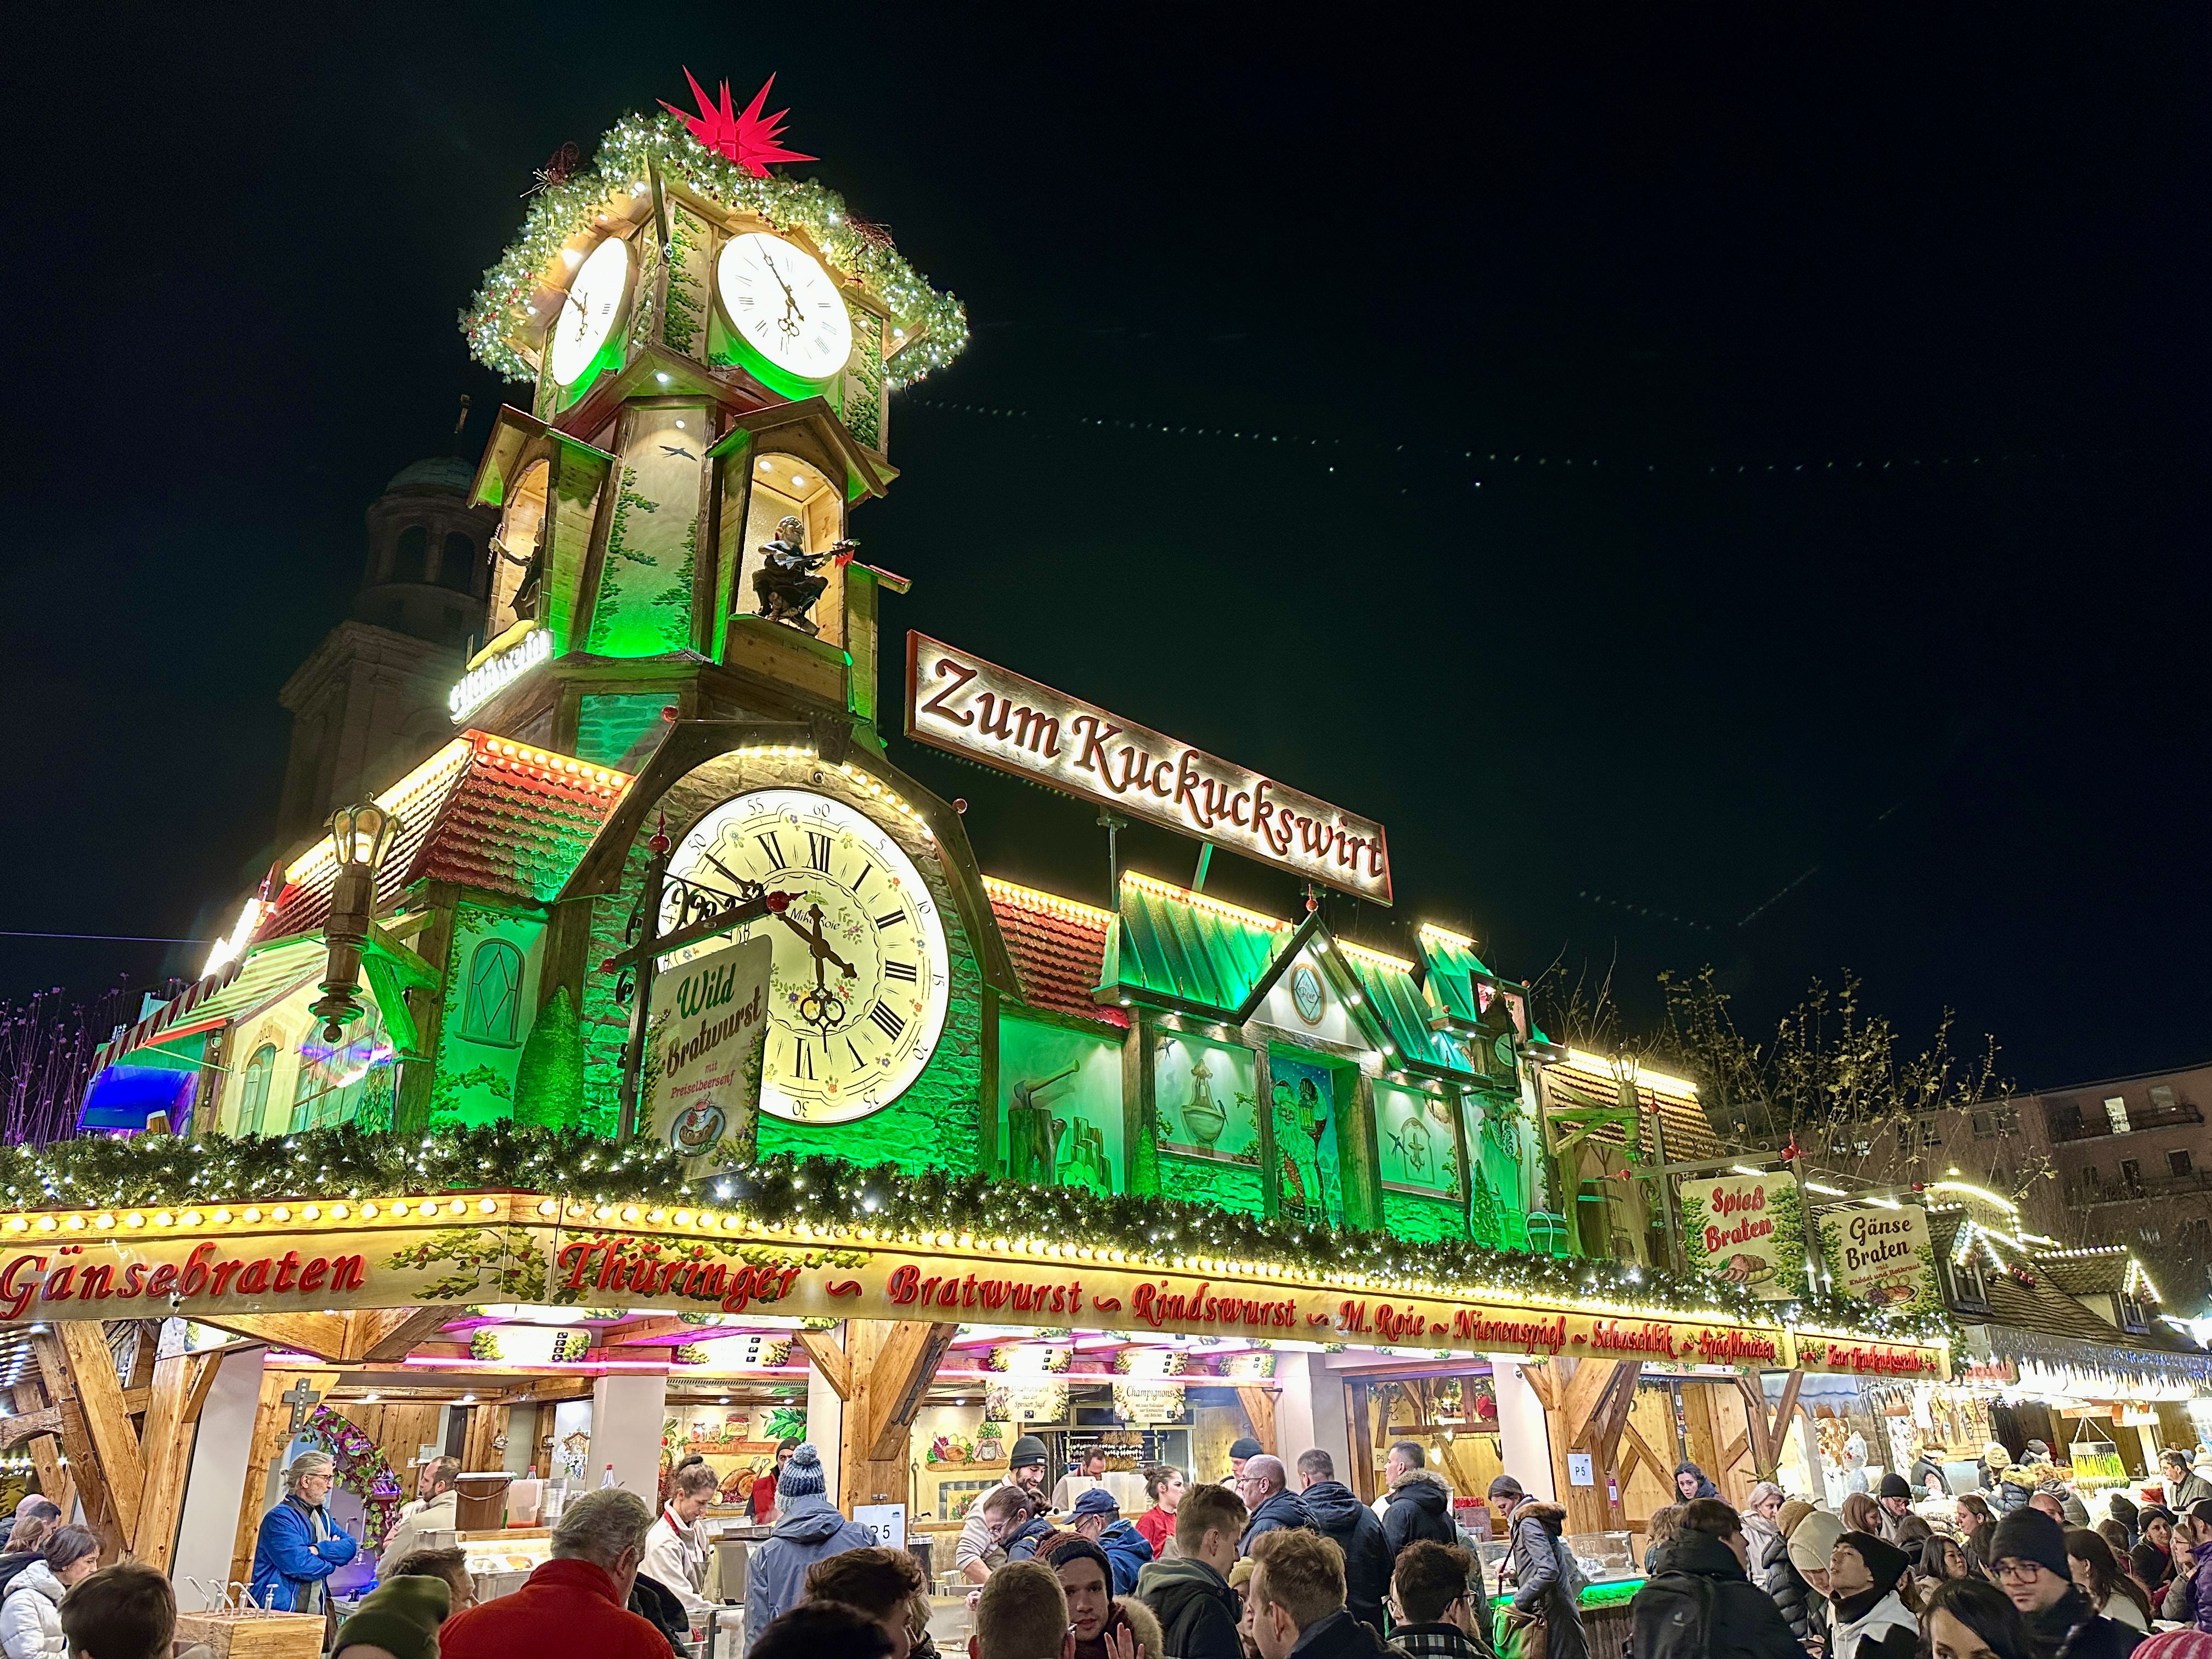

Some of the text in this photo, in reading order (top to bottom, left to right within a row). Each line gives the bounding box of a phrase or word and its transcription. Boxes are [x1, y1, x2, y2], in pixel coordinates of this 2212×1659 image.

[921, 658, 1383, 878] Zum Kuckuckswirt
[747, 797, 764, 816] 55
[813, 803, 830, 817] 60
[688, 833, 706, 856] 50
[753, 831, 792, 876] XI
[801, 831, 836, 876] XII
[875, 838, 887, 850] 5
[917, 900, 931, 914] 10
[884, 957, 917, 987] III
[676, 962, 736, 1019] Wild
[666, 985, 761, 1079] Bratwurst
[912, 1038, 928, 1060] 20
[705, 1060, 718, 1074] mit
[670, 1069, 736, 1099] Preiselbeersenf
[792, 1099, 810, 1118] 30
[863, 1088, 879, 1109] 25
[1712, 1185, 1765, 1218] Spieß
[1705, 1217, 1775, 1252] Braten
[1849, 1217, 1913, 1246] Gänse
[1845, 1240, 1911, 1271] Braten
[1875, 1263, 1889, 1271] mit
[0, 1241, 365, 1318] Gänsebraten
[1849, 1262, 1921, 1285] Knödel und Rotkraut
[557, 1237, 802, 1312] Thüringer
[887, 1264, 1083, 1314] Bratwurst
[1132, 1280, 1297, 1328] Rindswurst
[1339, 1300, 1373, 1332] M.
[1375, 1304, 1425, 1342] Roie
[1453, 1309, 1566, 1355] Nierenspieß
[1591, 1319, 1677, 1359] Schaschlik
[1126, 1385, 1173, 1401] Champignons
[1575, 1466, 1585, 1476] P 5
[883, 1525, 890, 1539] 5
